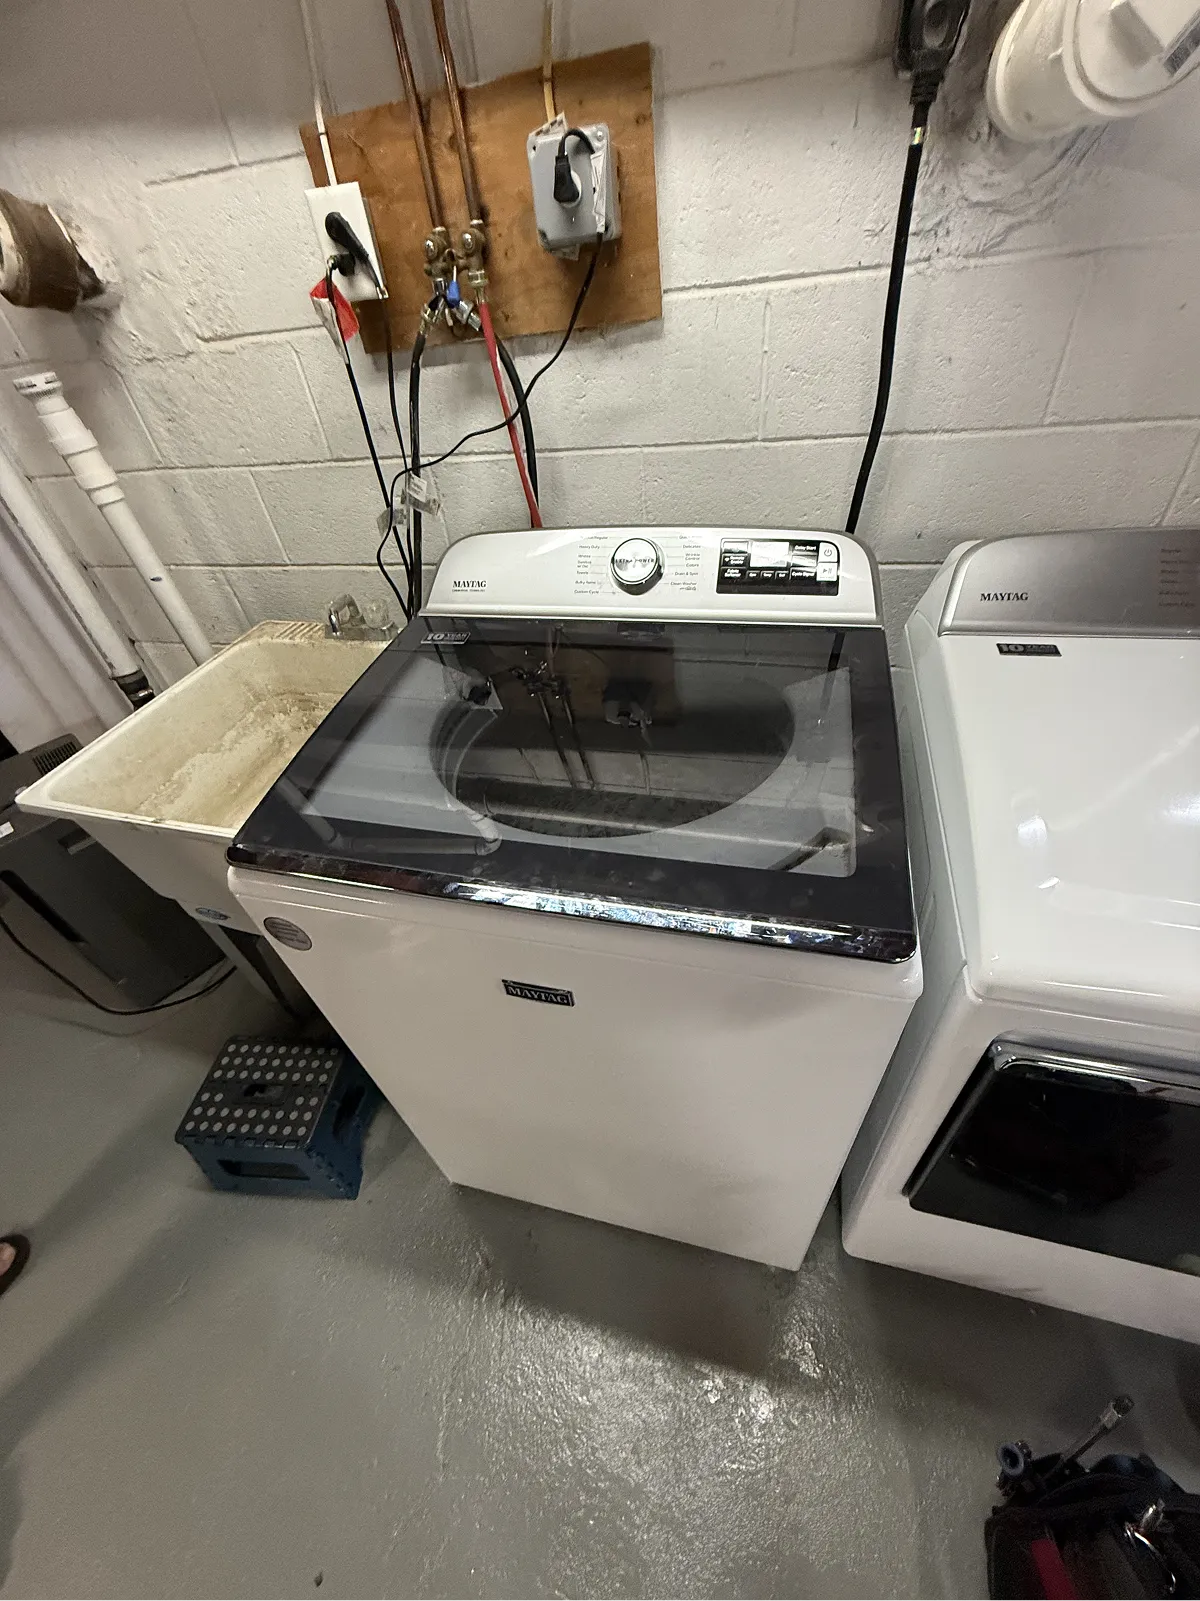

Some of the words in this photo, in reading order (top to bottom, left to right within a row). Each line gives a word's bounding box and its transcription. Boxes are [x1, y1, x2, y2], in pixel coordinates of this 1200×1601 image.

[453, 580, 487, 588] MAYTAG
[980, 592, 1029, 601] MAYTAG
[427, 633, 445, 641] 10
[1000, 644, 1025, 652] 10
[508, 986, 568, 1004] MAYTAG
